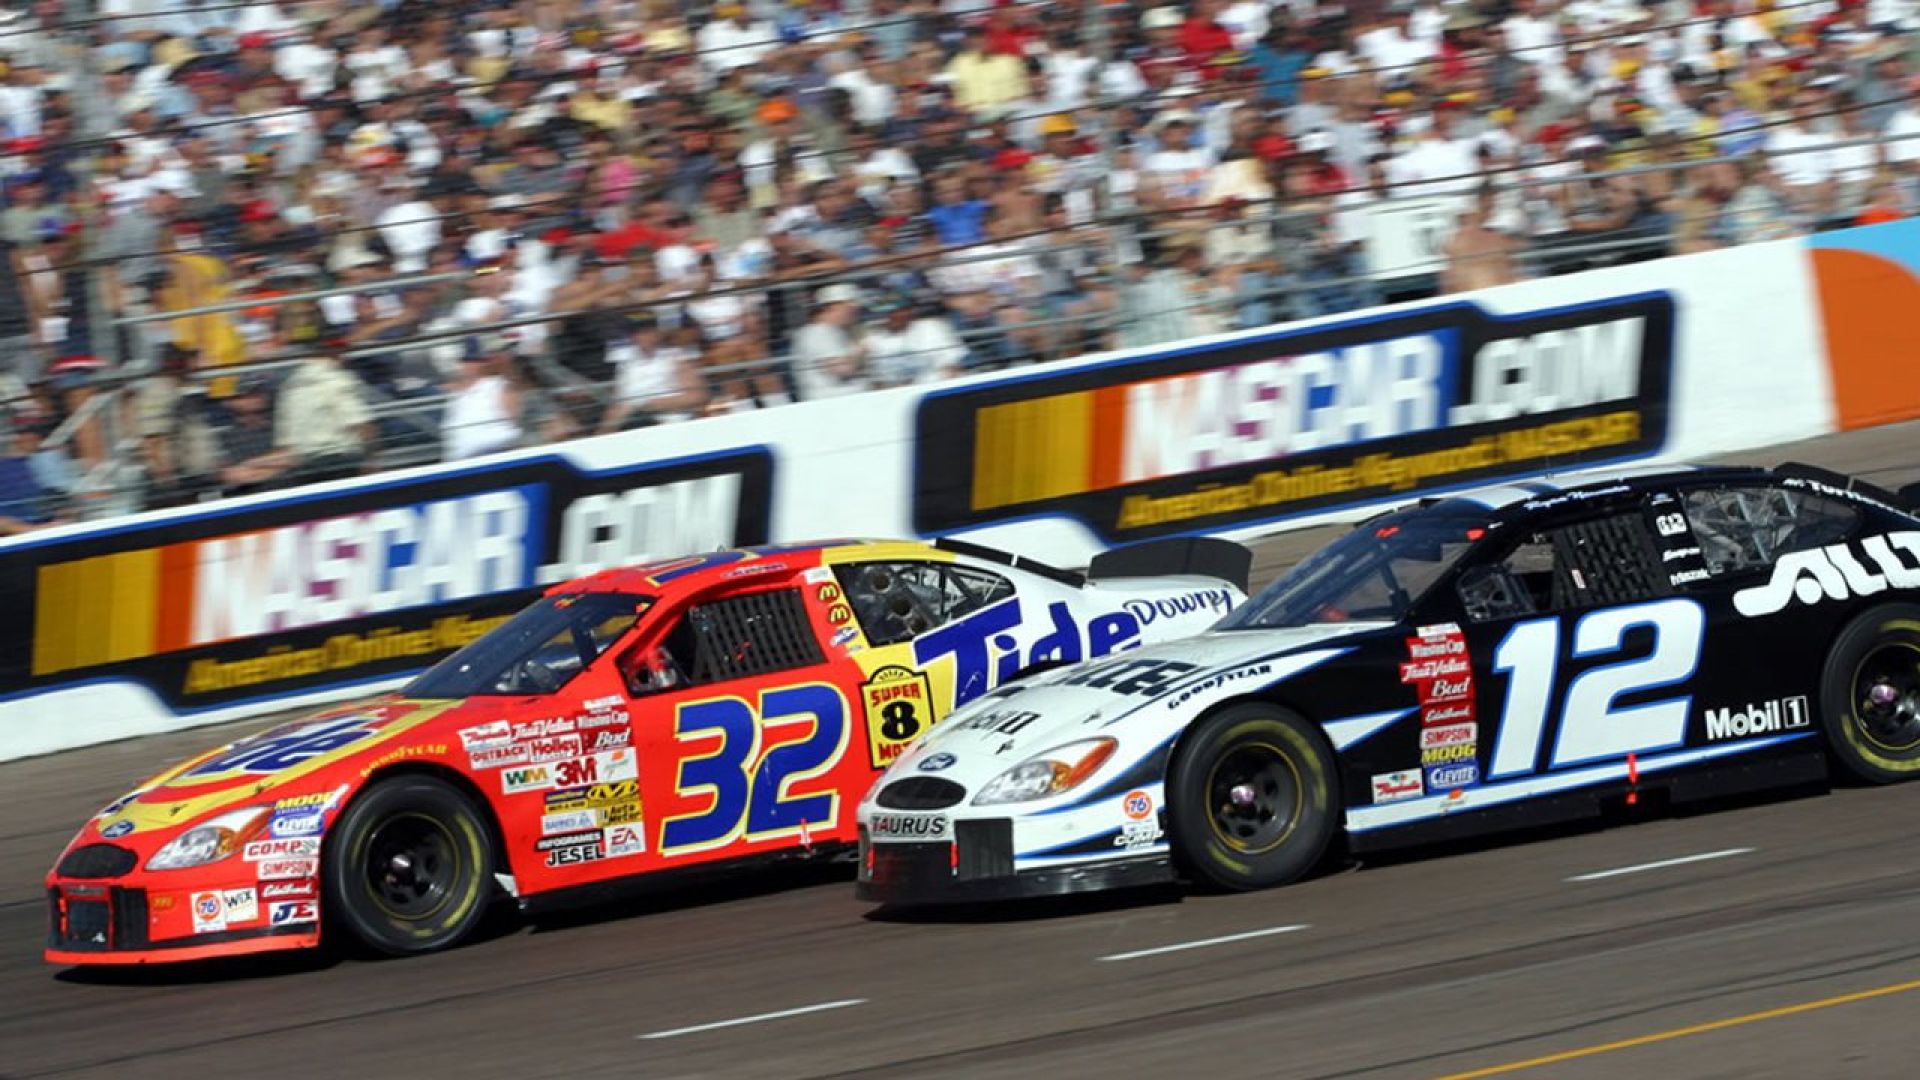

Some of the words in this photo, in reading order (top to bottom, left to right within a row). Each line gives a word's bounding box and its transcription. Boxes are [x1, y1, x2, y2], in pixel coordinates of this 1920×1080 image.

[1122, 334, 1443, 480] NASCAR
[1449, 317, 1646, 427] .COM
[194, 489, 528, 646] NASCAR
[537, 473, 744, 586] .COM
[1123, 587, 1232, 627] Downy
[913, 597, 1142, 710] Tide
[870, 682, 921, 708] SUPER
[1168, 664, 1271, 709] GOODYEAR
[1431, 676, 1470, 697] Bud
[1487, 597, 1706, 780] 12
[881, 701, 921, 740] 8
[1704, 699, 1781, 740] Mobil
[596, 726, 630, 746] Bud
[1425, 729, 1471, 745] SIMPSON
[532, 738, 579, 757] Holley
[1422, 744, 1476, 763] MOOG
[556, 757, 597, 786] 3M
[658, 681, 851, 856] 32
[1129, 797, 1147, 813] 76
[611, 827, 639, 845] EA
[869, 816, 947, 835] TAURUS
[248, 840, 301, 856] COMP
[547, 845, 606, 867] JESEL
[263, 860, 313, 876] SIMPSON
[200, 901, 217, 914] 76
[272, 902, 313, 923] JE
